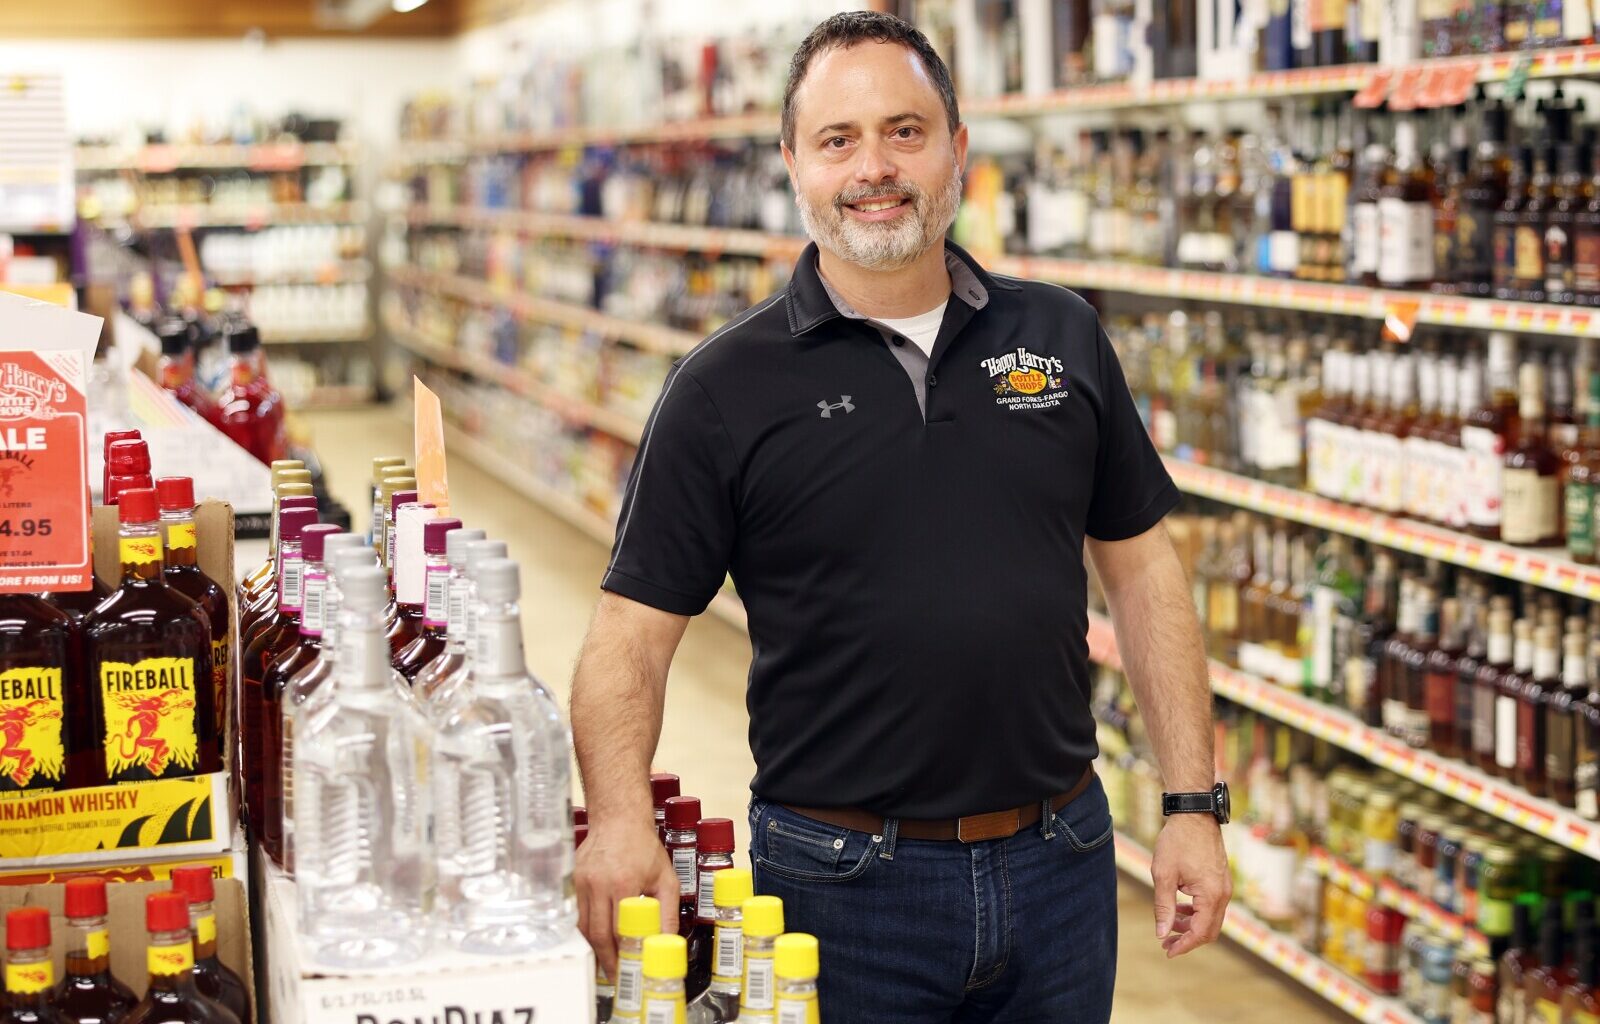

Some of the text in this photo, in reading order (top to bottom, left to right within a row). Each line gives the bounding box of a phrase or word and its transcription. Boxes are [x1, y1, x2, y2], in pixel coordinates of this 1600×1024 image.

[981, 347, 1064, 378] Happy Harry's
[2, 362, 67, 403] Harry's
[1011, 374, 1043, 382] BOTTLE
[1015, 382, 1043, 390] SHOPS
[996, 397, 1021, 405] GRAND
[1009, 400, 1060, 411] NORTH DAKOTA
[24, 575, 60, 585] FROM
[61, 574, 83, 584] US!
[106, 666, 189, 693] FIREBALL
[69, 790, 139, 814] WHISKY
